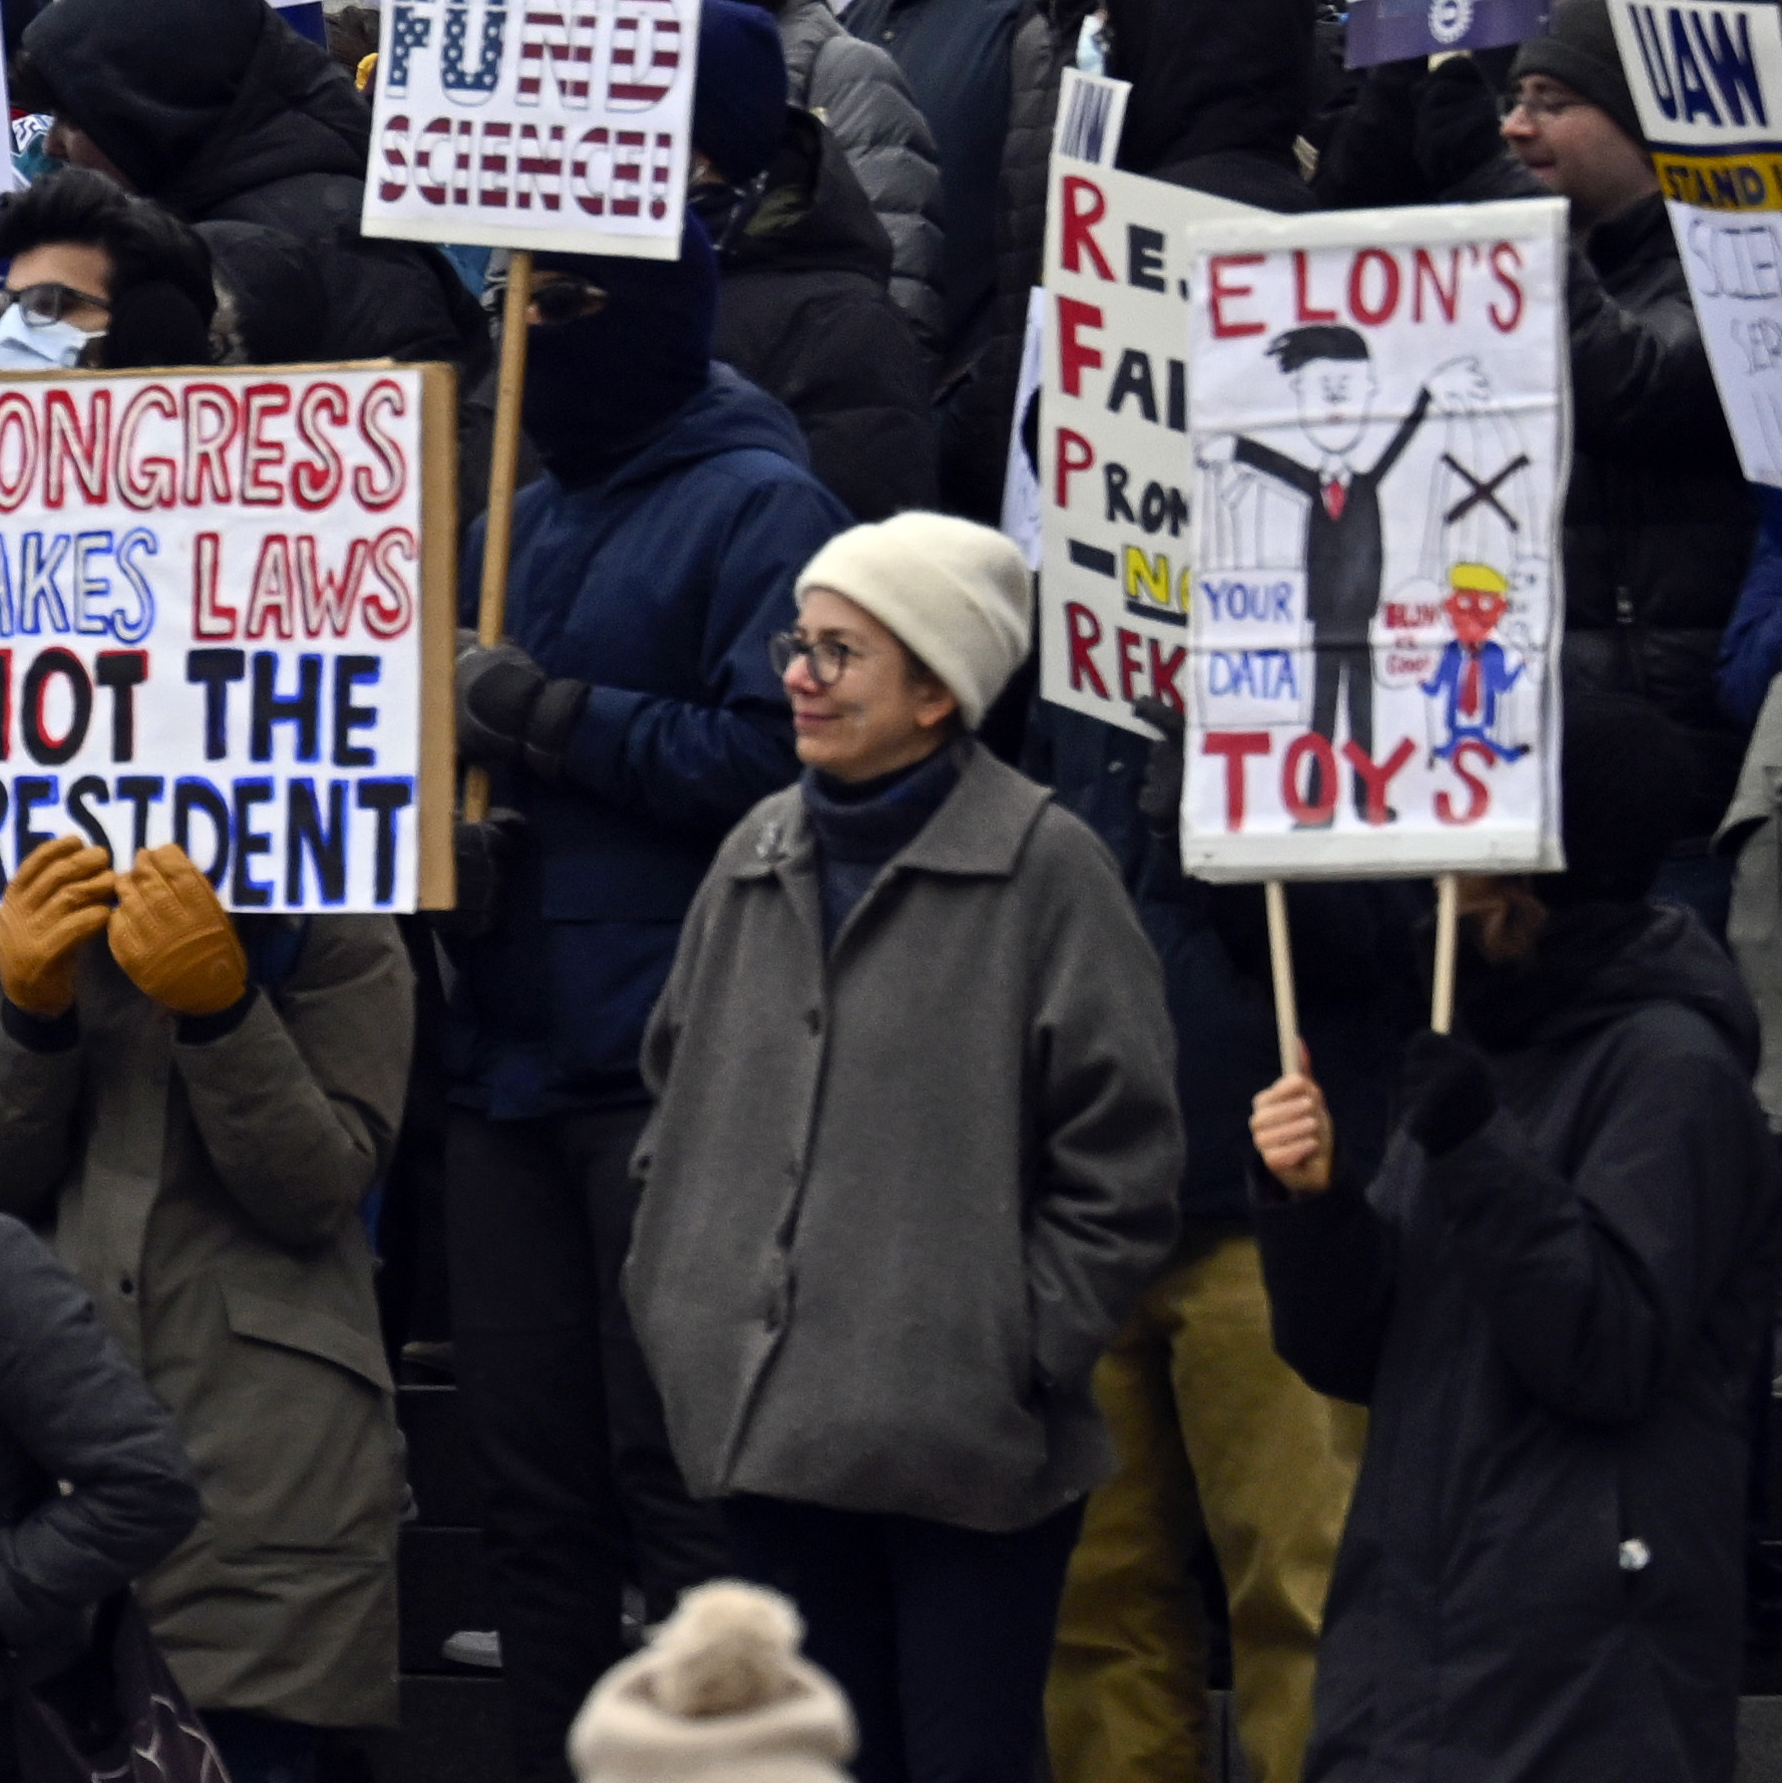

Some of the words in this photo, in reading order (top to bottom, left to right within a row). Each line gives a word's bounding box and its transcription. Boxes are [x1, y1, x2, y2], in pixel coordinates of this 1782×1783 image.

[1627, 3, 1767, 127] UAW
[378, 114, 672, 220] SCIENCE!
[1664, 165, 1766, 207] STAND
[1206, 238, 1526, 339] ELON'S
[191, 526, 419, 642] LAWS
[1201, 582, 1294, 622] YOUR
[186, 651, 381, 766] THE
[1208, 648, 1300, 701] DATA
[1202, 731, 1496, 834] TOYS
